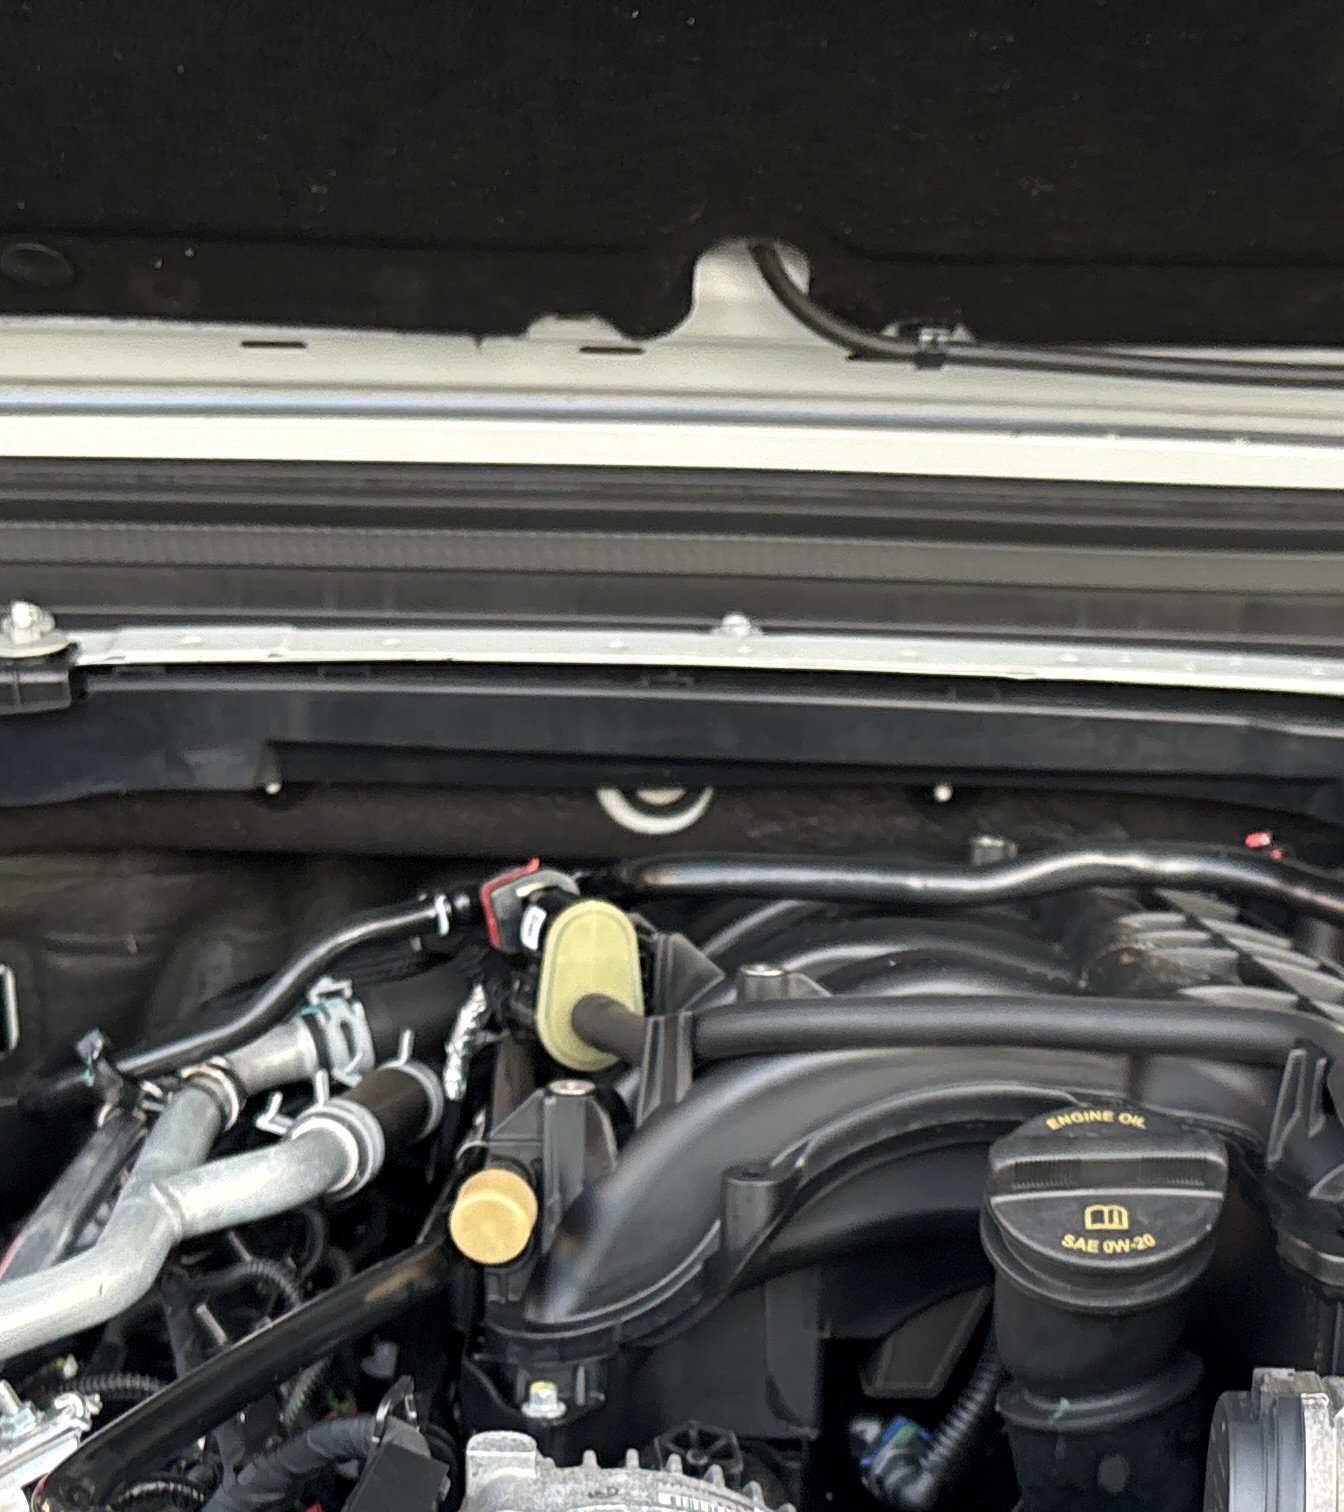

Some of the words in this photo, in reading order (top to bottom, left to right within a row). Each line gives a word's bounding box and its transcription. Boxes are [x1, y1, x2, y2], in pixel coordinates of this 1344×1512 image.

[1045, 1109, 1114, 1131] ENGINE
[1118, 1112, 1147, 1130] OIL
[1061, 1233, 1100, 1255] SAE
[1102, 1233, 1157, 1255] 0W-20
